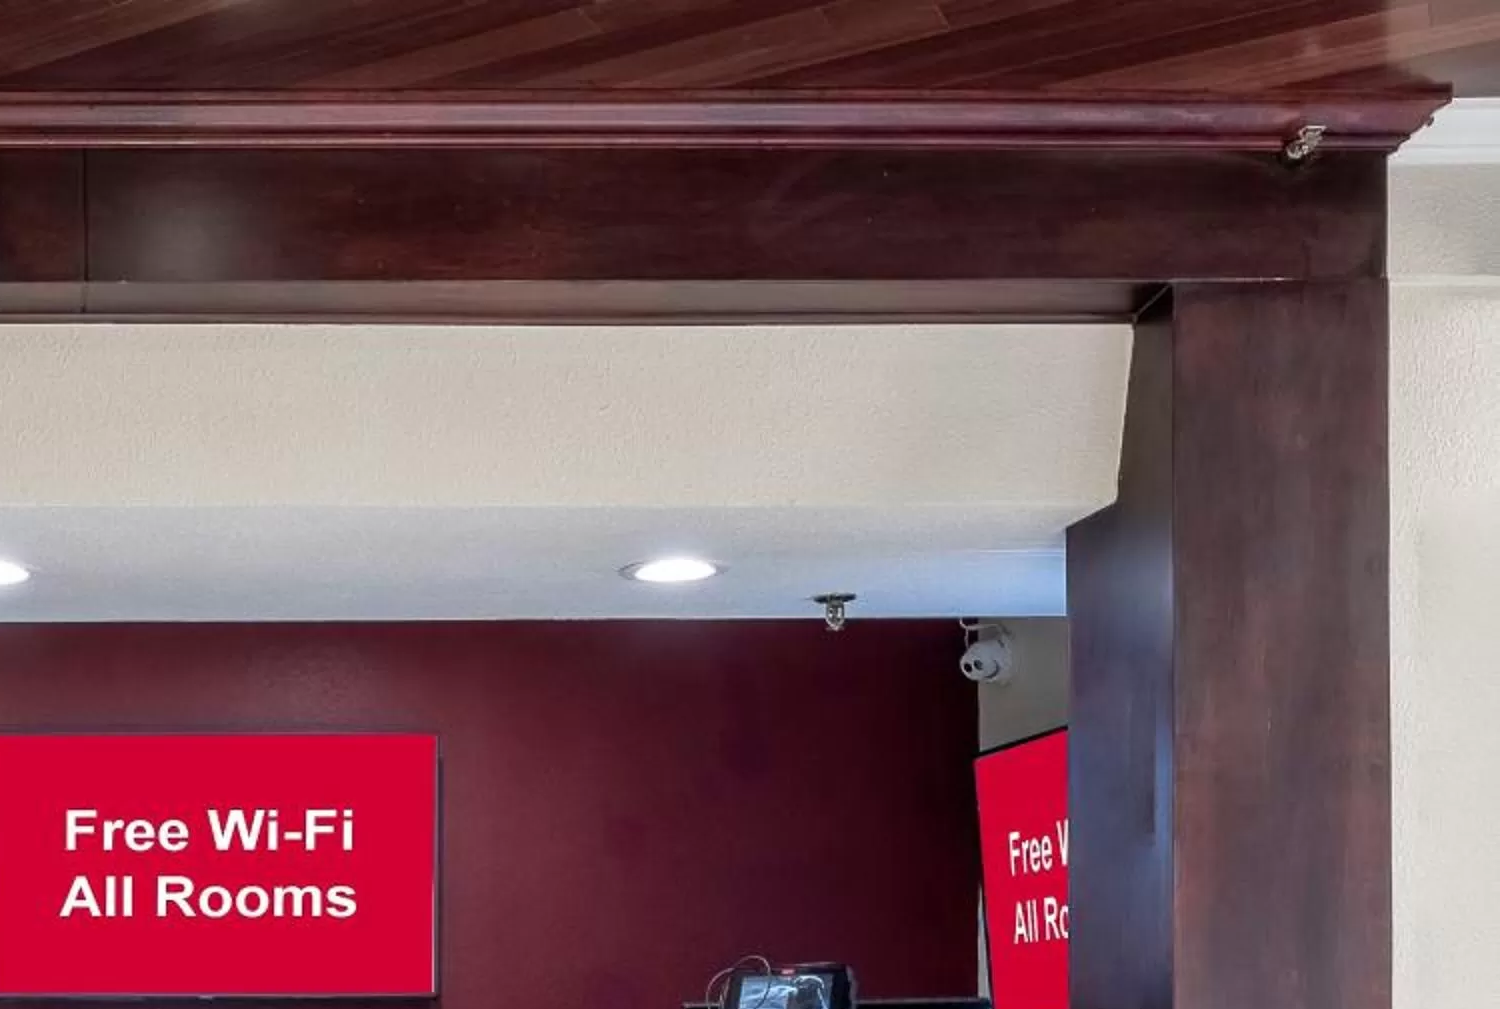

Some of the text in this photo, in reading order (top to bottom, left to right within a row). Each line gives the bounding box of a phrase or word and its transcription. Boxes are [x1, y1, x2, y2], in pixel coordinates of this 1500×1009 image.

[65, 809, 354, 852] Free Wi-Fi
[1008, 831, 1053, 877] Free
[59, 875, 358, 918] All Rooms
[1014, 899, 1039, 944] All
